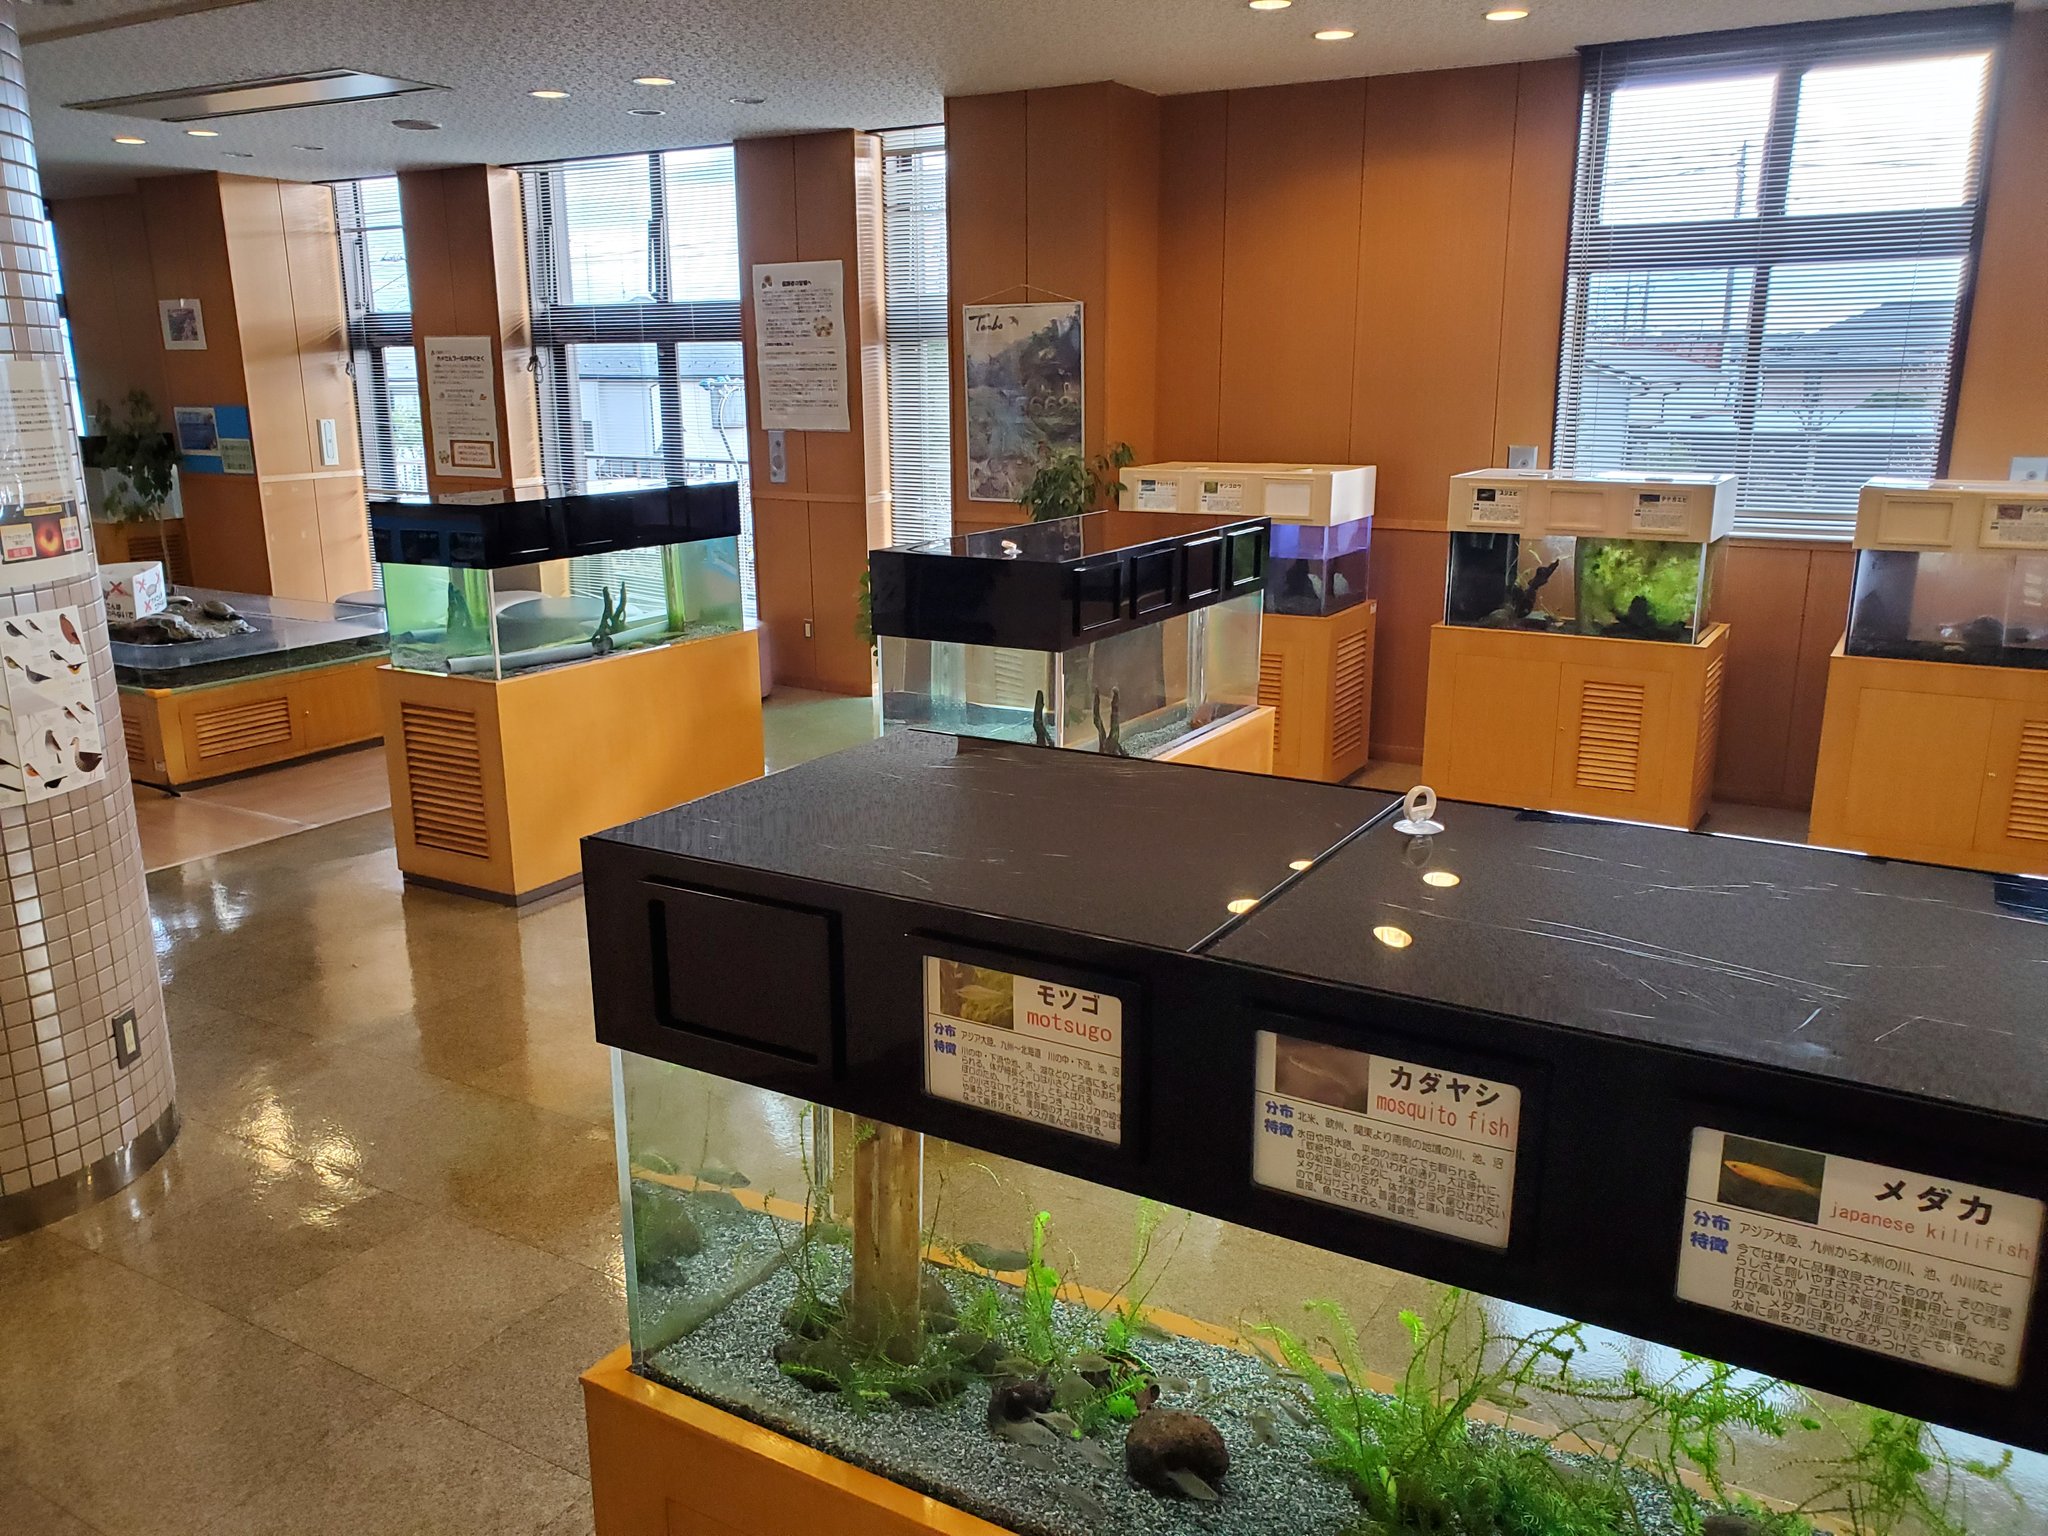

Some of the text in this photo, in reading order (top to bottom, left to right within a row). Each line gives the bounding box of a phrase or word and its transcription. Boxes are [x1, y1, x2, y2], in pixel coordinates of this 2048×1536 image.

[1037, 984, 1100, 1015] モツゴ
[933, 1020, 956, 1038] 分布
[1026, 1010, 1112, 1042] motsugo
[933, 1037, 956, 1056] 特徴
[1390, 1065, 1500, 1107] カダヤシ
[1264, 1098, 1294, 1120] 分布
[1376, 1094, 1510, 1138] mosquito fish
[1263, 1116, 1294, 1138] 特徴
[1874, 1180, 1993, 1226] メダカ
[1691, 1208, 1731, 1233] 分布
[1829, 1201, 2031, 1260] japanese killifish
[1688, 1229, 1729, 1255] 特徴
